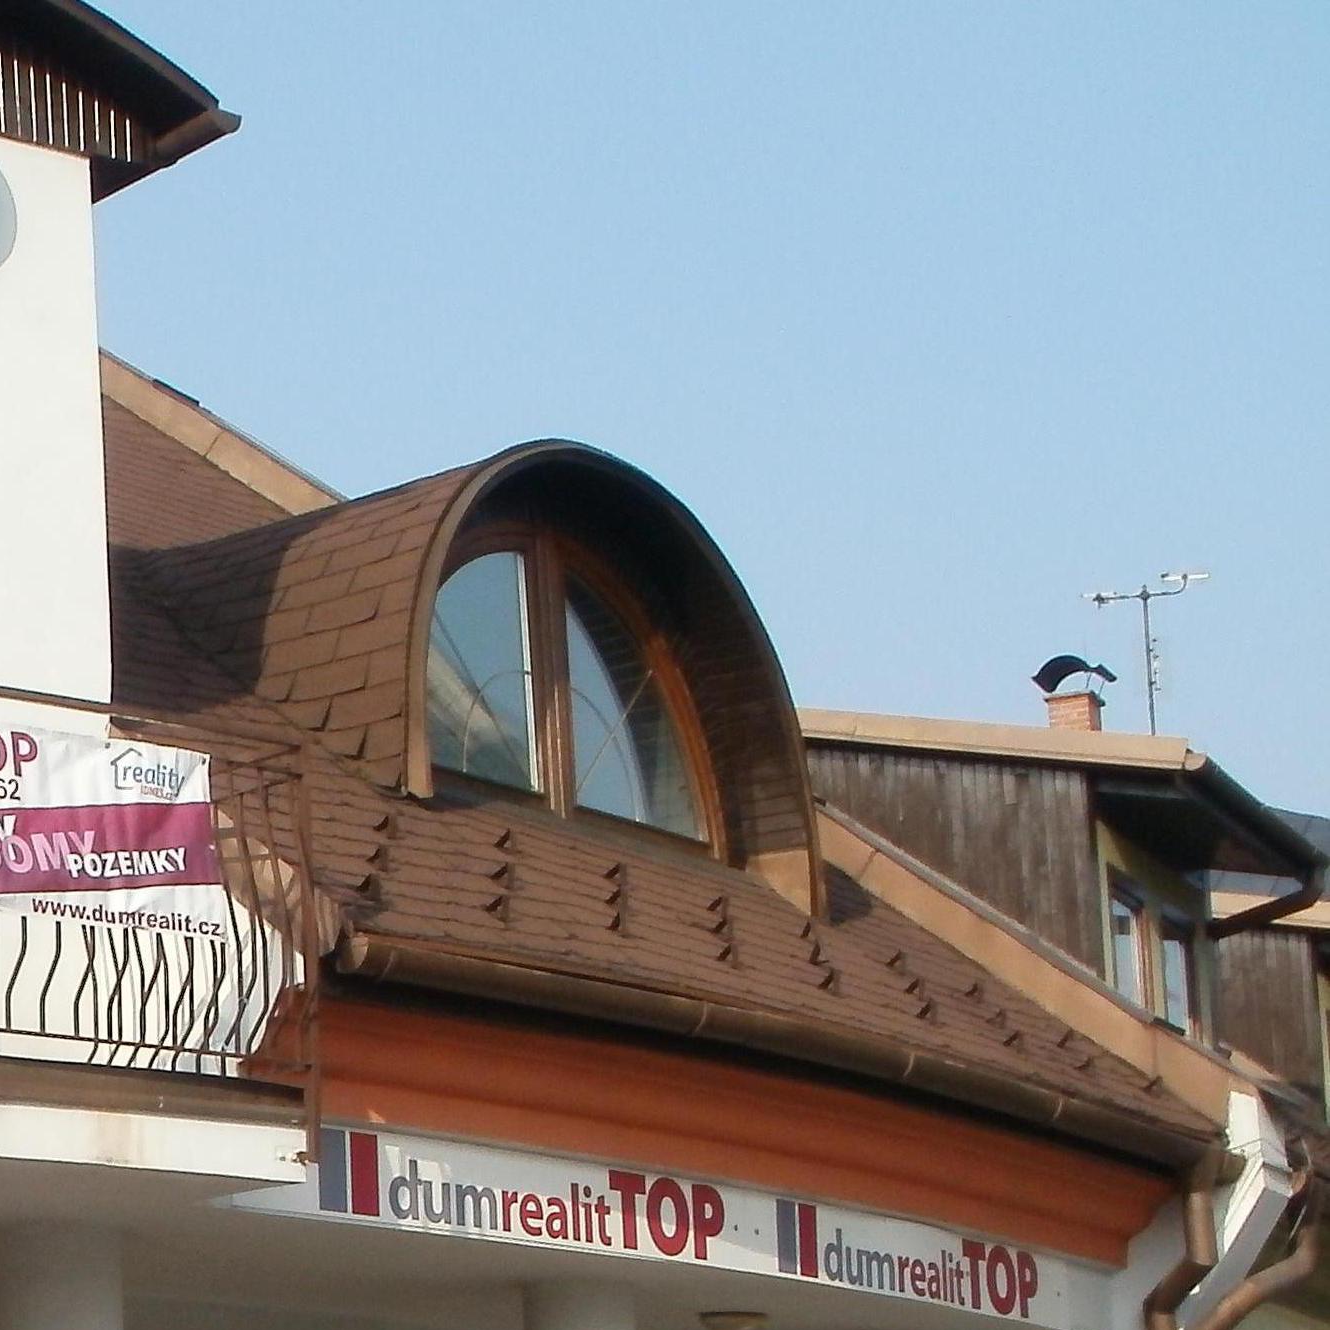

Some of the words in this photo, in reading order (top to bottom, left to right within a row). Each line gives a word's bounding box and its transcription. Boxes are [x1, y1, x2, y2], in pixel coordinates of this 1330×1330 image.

[123, 763, 186, 798] reality
[67, 848, 187, 879] POZEMKY
[32, 897, 222, 936] www.dumrealit.cz
[387, 1159, 727, 1261] dumrealitTOP
[823, 1229, 1039, 1320] dumrealitTOP
